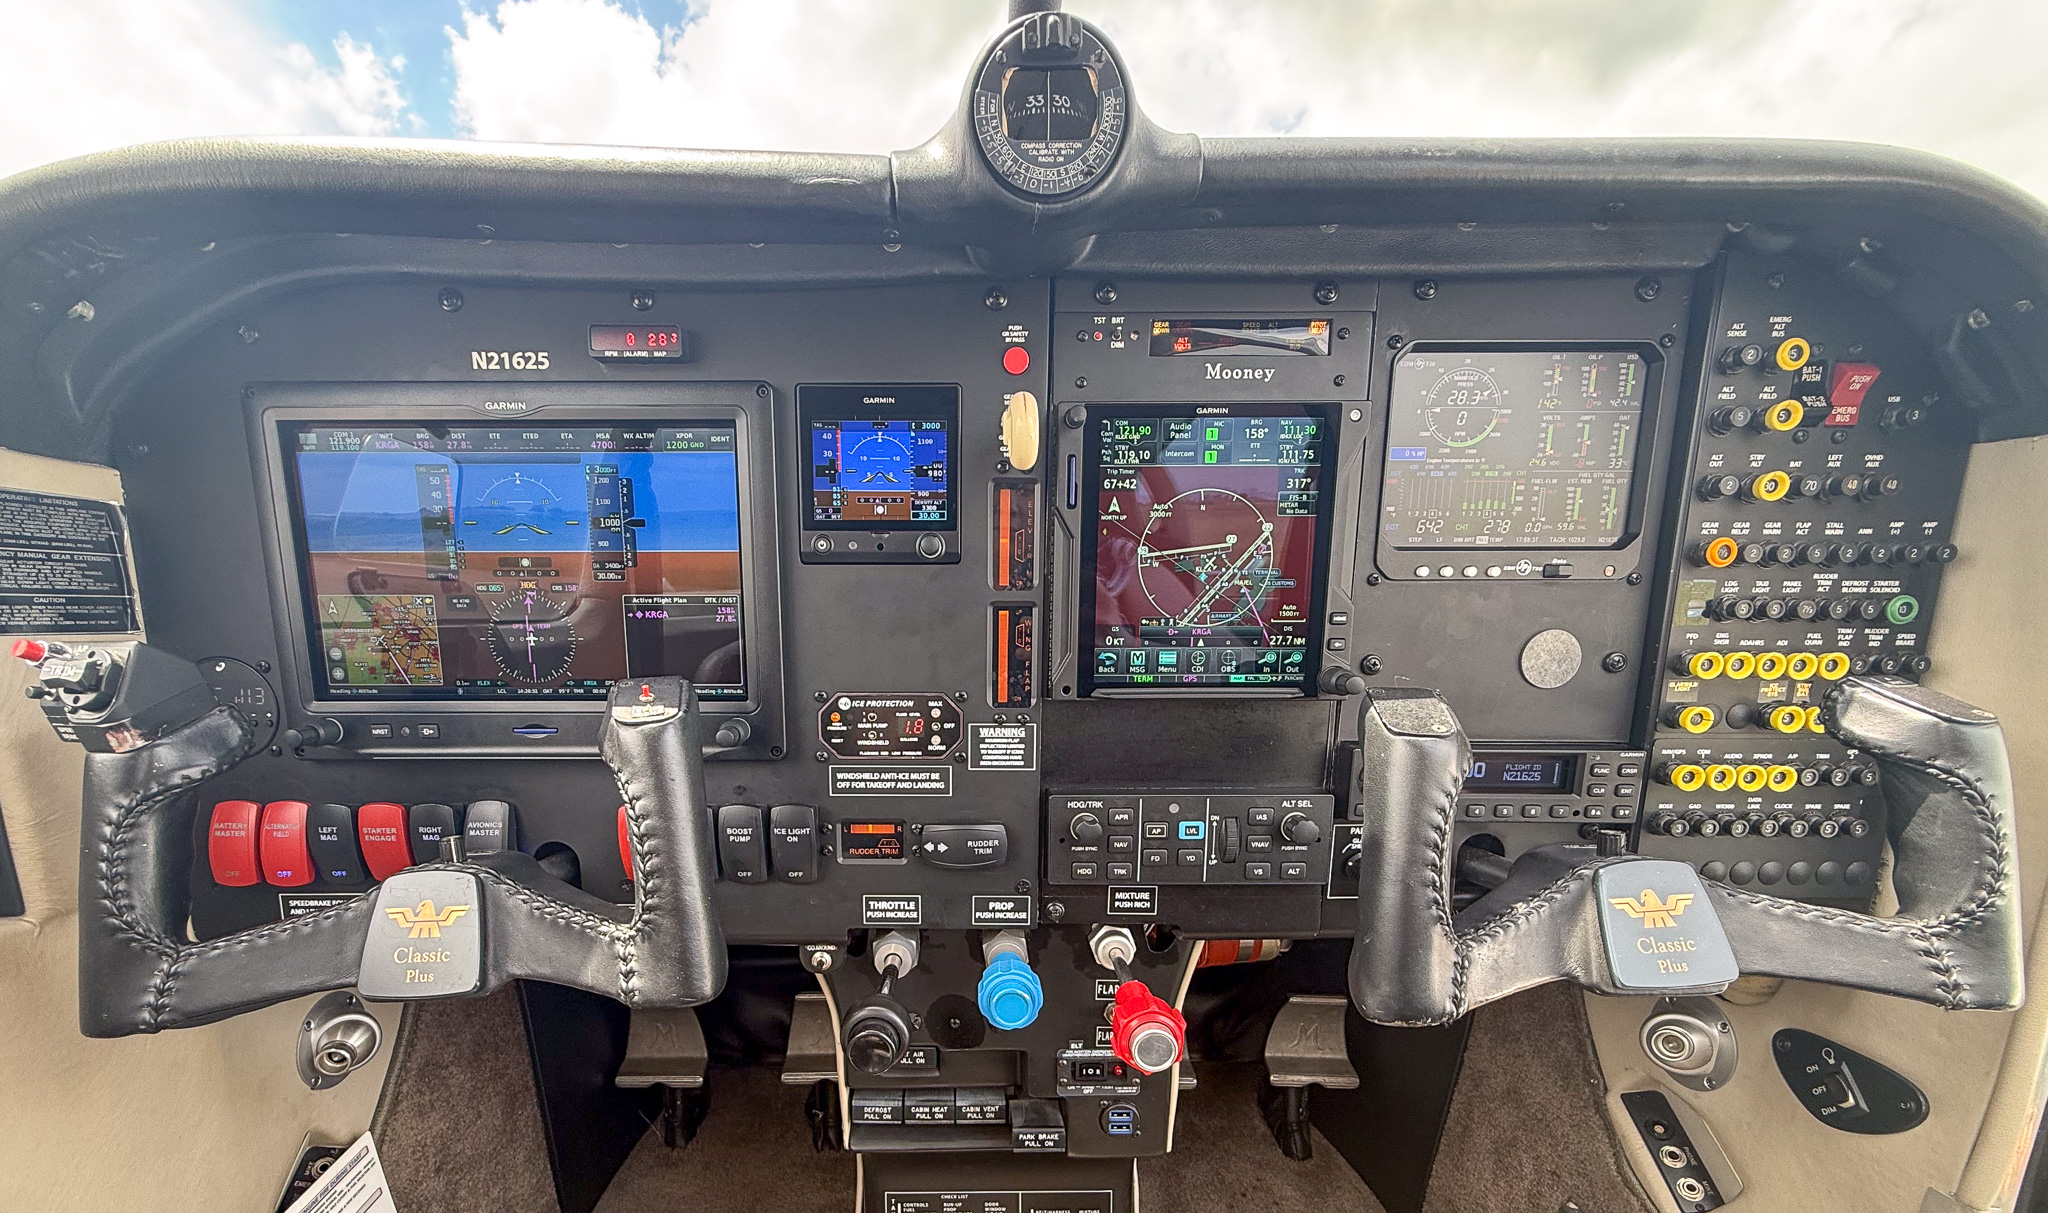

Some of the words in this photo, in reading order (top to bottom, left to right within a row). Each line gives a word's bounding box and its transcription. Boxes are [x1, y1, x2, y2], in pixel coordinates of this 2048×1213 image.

[1026, 95, 1044, 108] 33
[1053, 96, 1070, 107] 30
[471, 352, 550, 370] N21625
[1205, 363, 1275, 381] Mooney
[1802, 366, 1823, 374] BAT-1
[1802, 374, 1821, 382] PUSH
[1850, 375, 1872, 383] PUSH
[485, 402, 526, 411] GARMIN
[1832, 407, 1857, 415] EMERG
[1835, 414, 1850, 422] BUS
[1119, 426, 1151, 435] 121.90
[1170, 423, 1192, 431] Audio
[1284, 426, 1316, 435] 111.30
[1170, 431, 1191, 440] Panel
[375, 441, 400, 450] KRGA
[666, 441, 688, 449] 1200
[1118, 451, 1150, 460] 119.10
[1282, 450, 1314, 459] 111.75
[1104, 479, 1137, 489] 67+42
[1805, 481, 1818, 490] 70
[1417, 520, 1444, 533] 642
[1484, 520, 1511, 533] 278
[74, 554, 111, 562] EXTENSION
[645, 611, 669, 619] KRGA
[1270, 637, 1292, 646] 27.7
[867, 700, 914, 708] PROTECTION
[980, 728, 1026, 737] WARNING
[1503, 772, 1541, 781] N21625
[468, 821, 502, 829] AVIONICS
[365, 834, 397, 842] ENGAGE
[1115, 892, 1150, 900] MIXTURE
[869, 902, 916, 910] THROTTLE
[989, 902, 1014, 910] PROP
[1636, 936, 1696, 955] Classic
[394, 947, 450, 964] Classic
[1657, 960, 1689, 974] Plus
[406, 970, 434, 983] Plus
[1806, 1065, 1819, 1073] ON
[1812, 1085, 1827, 1095] OFF
[1821, 1106, 1837, 1116] DIM
